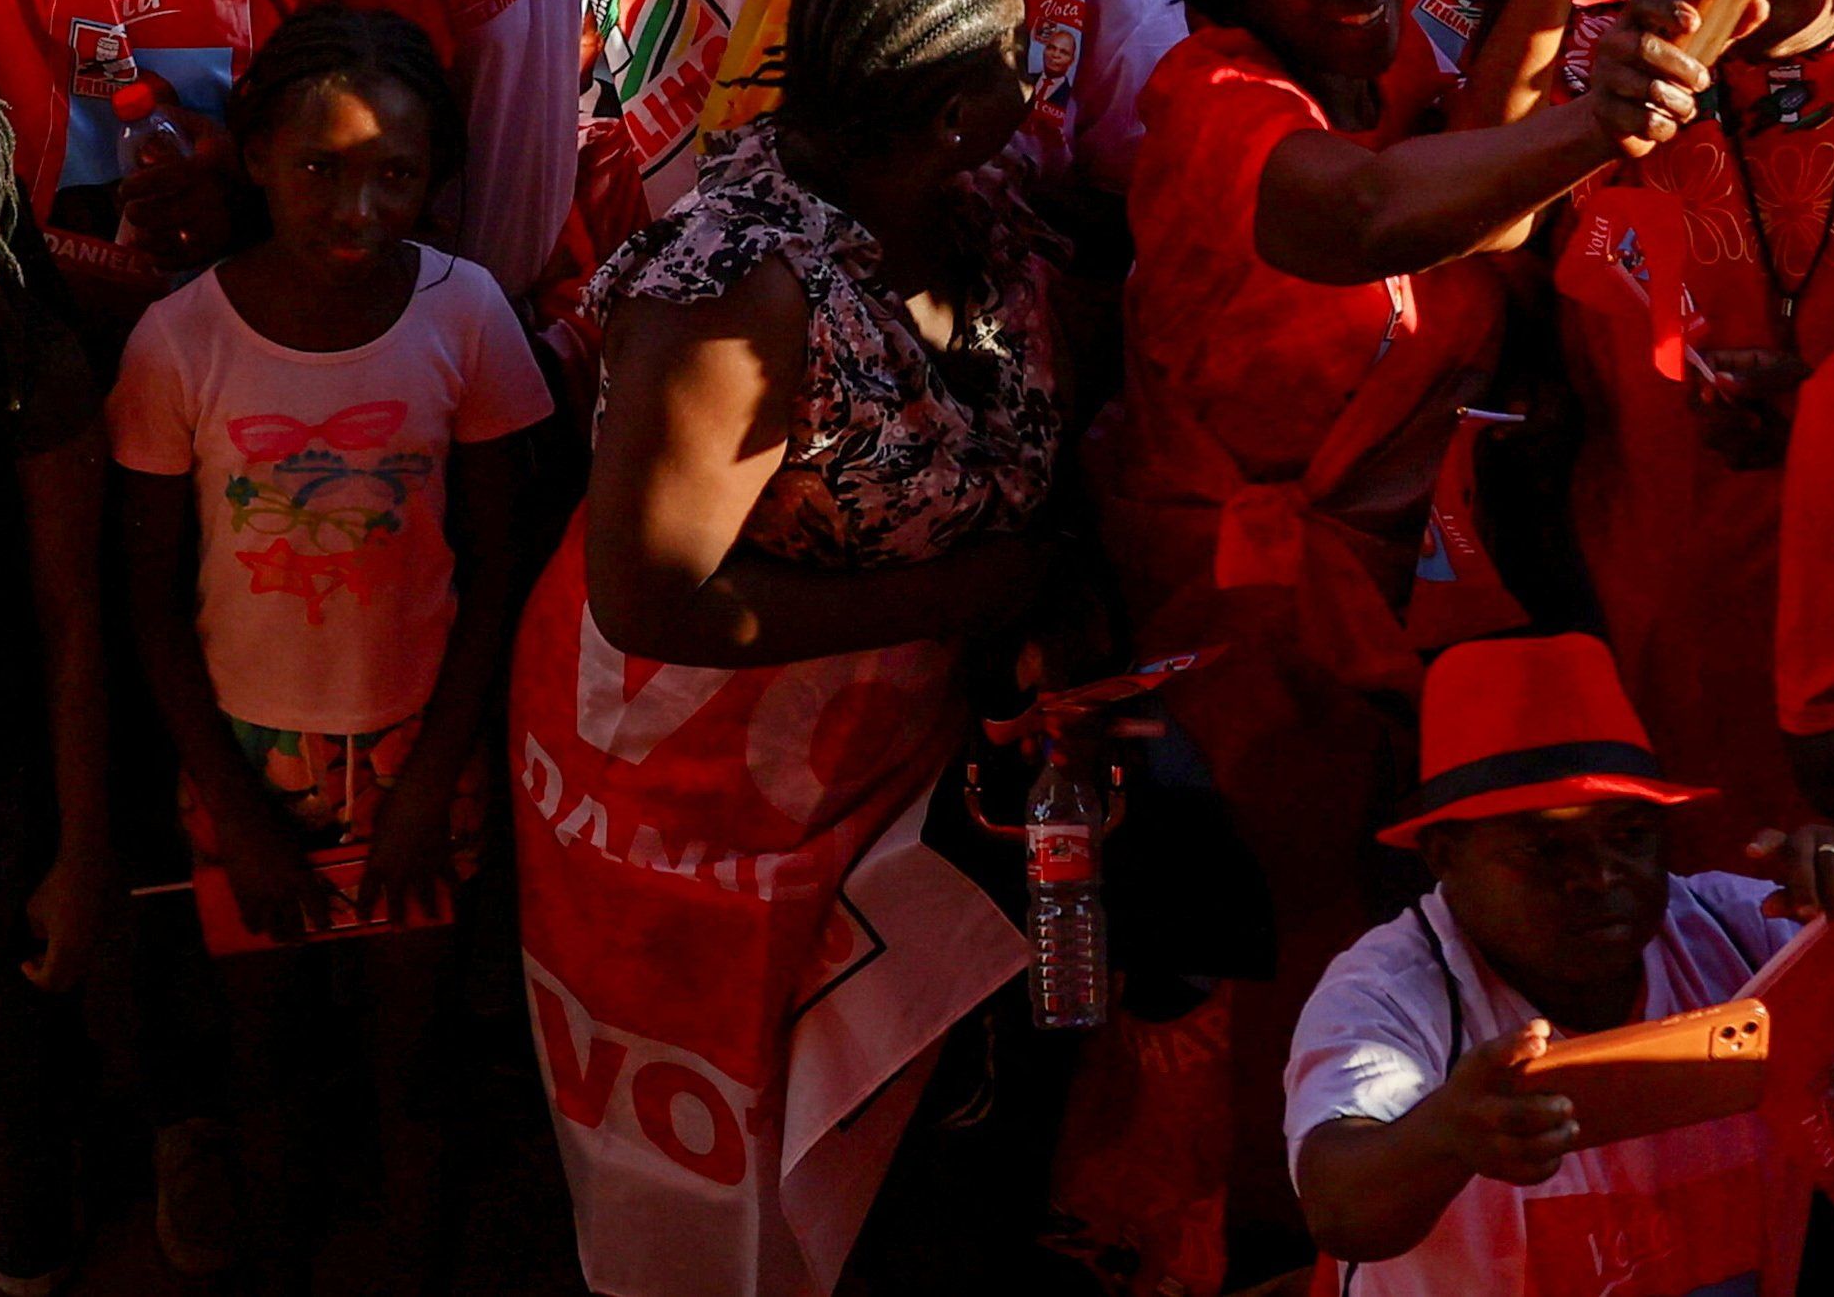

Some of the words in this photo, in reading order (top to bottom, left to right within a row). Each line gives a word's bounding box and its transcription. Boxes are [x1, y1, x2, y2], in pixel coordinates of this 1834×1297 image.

[1040, 0, 1079, 18] Vota
[625, 36, 727, 168] LIMO
[43, 231, 136, 268] DANIEL
[1585, 214, 1610, 258] Vota
